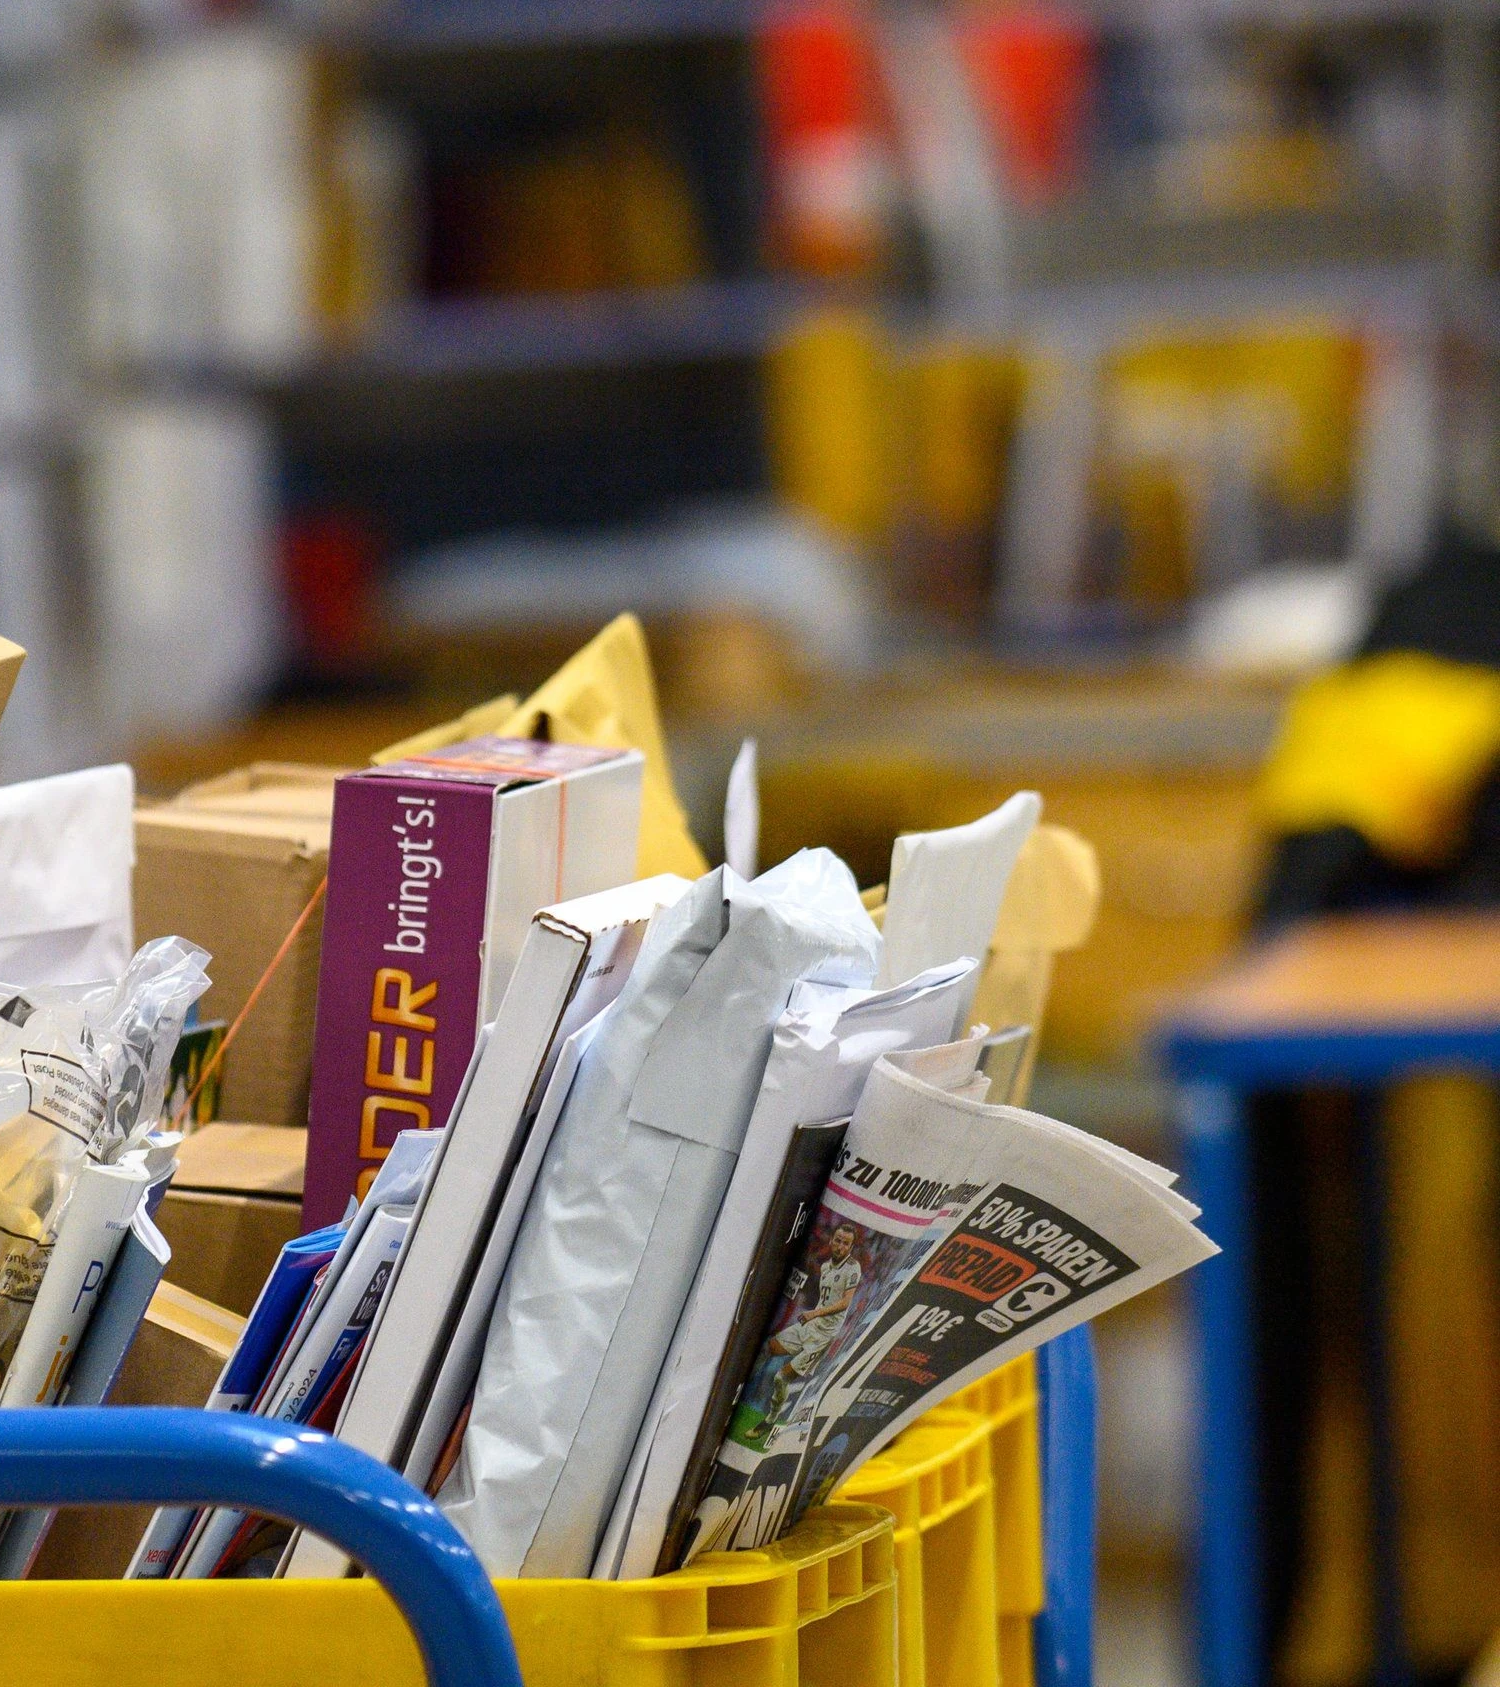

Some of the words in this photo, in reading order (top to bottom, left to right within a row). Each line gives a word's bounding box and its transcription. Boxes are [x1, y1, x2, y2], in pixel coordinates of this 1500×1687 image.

[383, 796, 442, 954] bringt's!
[357, 967, 438, 1200] DER
[843, 1157, 883, 1189] zu
[925, 1240, 1025, 1294] PREPAID
[969, 1196, 1034, 1239] 50%
[1012, 1218, 1120, 1288] SPAREN
